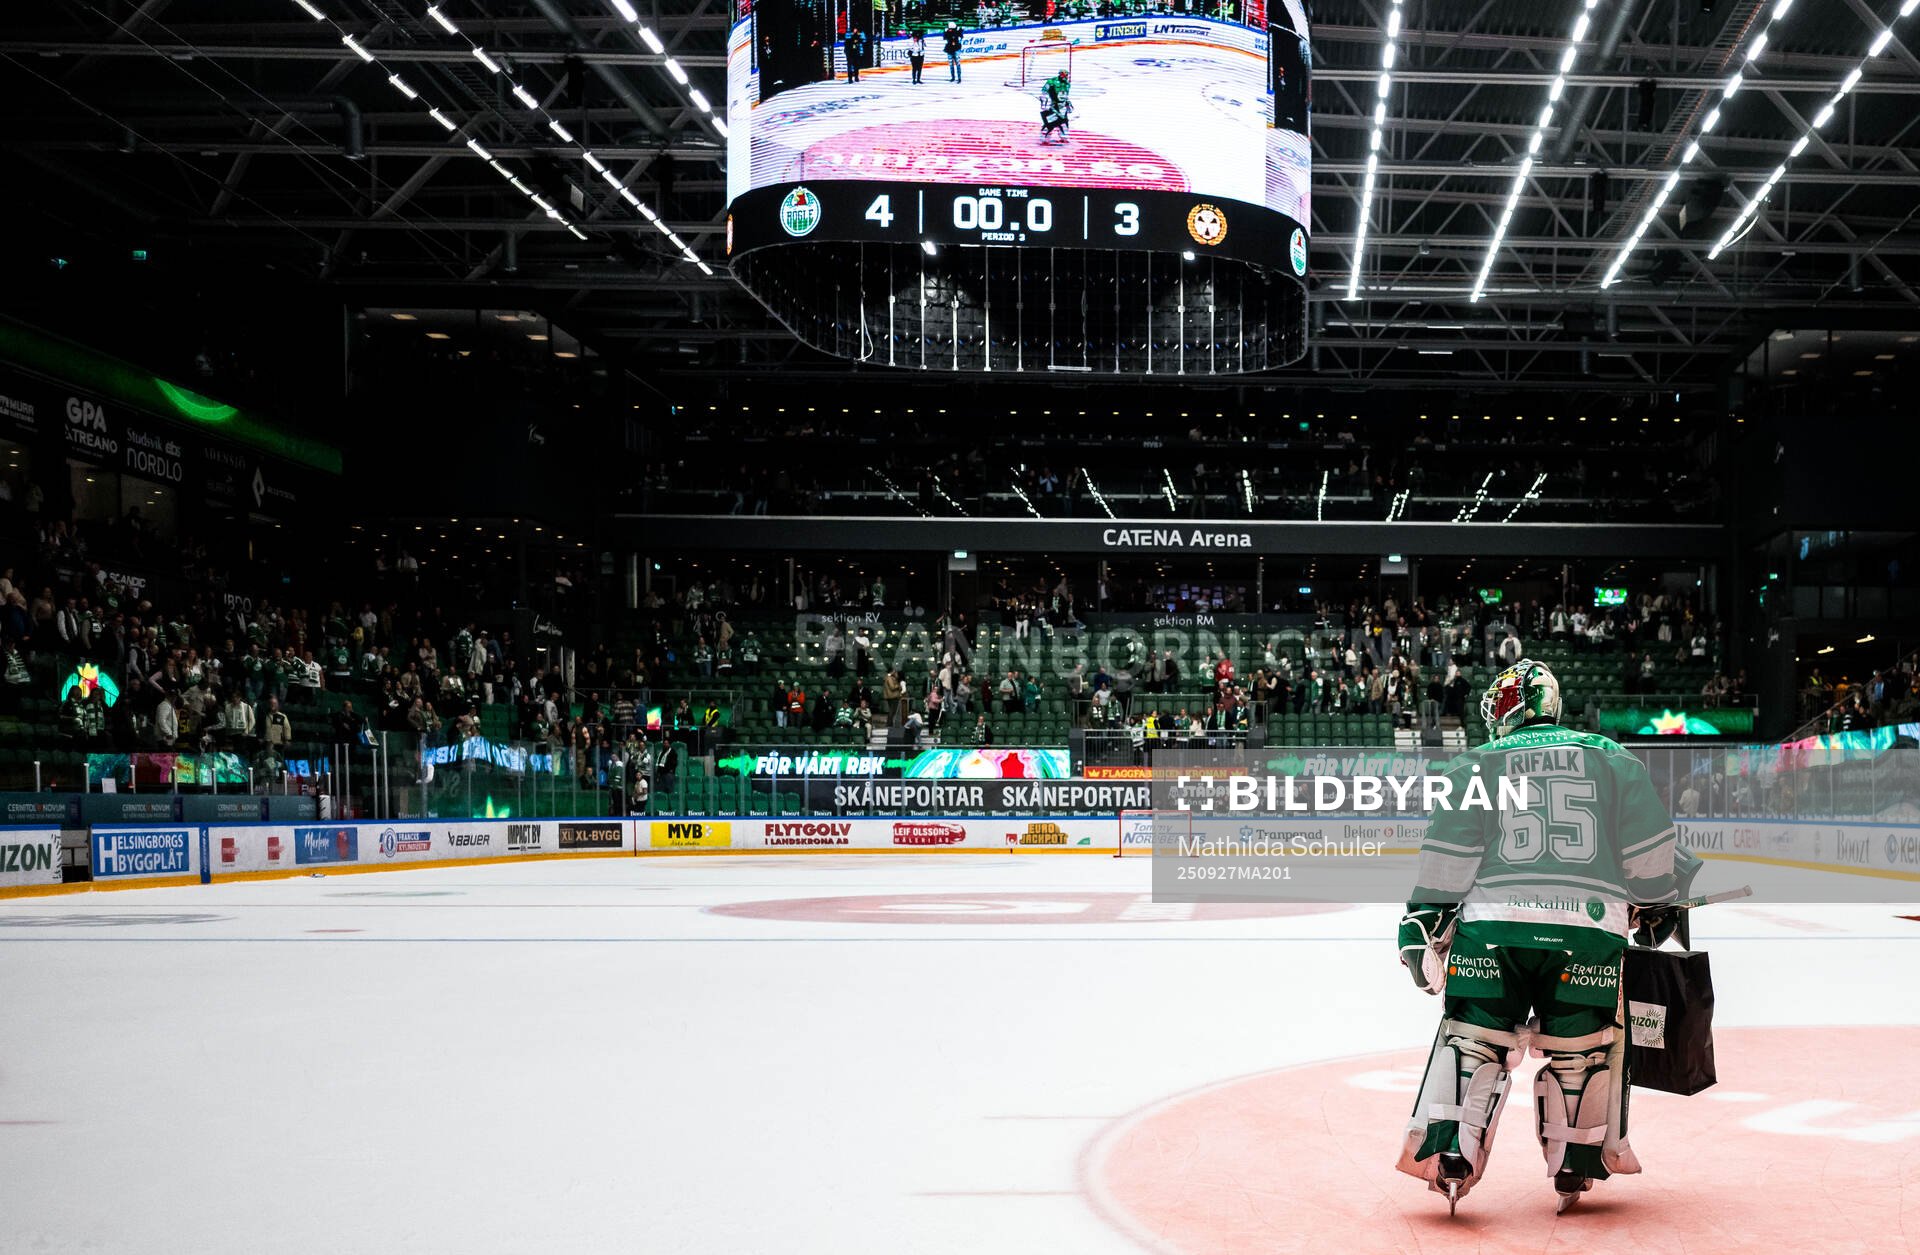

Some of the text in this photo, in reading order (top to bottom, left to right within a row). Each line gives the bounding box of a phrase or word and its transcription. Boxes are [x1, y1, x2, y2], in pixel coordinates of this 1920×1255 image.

[979, 188, 1028, 198] GAME TIME
[865, 195, 893, 227] 4
[953, 196, 1053, 231] 00.0
[1114, 204, 1139, 236] 3
[982, 232, 1026, 242] PERIOD 3
[66, 397, 108, 433] GPA
[1103, 529, 1252, 547] CATENA Arena
[822, 612, 881, 624] sektion RV
[1154, 615, 1214, 627] sektion RM
[755, 750, 886, 775] FÖR VÅRT RBK
[1303, 752, 1430, 776] FÖR VÅRT RBK
[1510, 750, 1580, 775] RIFALK
[1185, 769, 1227, 779] KRONAN
[834, 781, 984, 807] SKÅNEPORTAR
[1002, 781, 1151, 807] SKÅNEPORTAR
[765, 823, 852, 836] FLYTGOLV
[1028, 823, 1057, 834] EURO
[1497, 777, 1598, 864] 65
[508, 824, 542, 844] IMPACT BY
[562, 831, 573, 841] XL
[668, 824, 703, 838] MVB
[894, 828, 950, 836] LEIF OLSSONS
[1020, 833, 1069, 845] JACKPOT
[1344, 825, 1381, 839] Dekor
[1677, 824, 1724, 851] Boozt
[1836, 829, 1870, 864] Boozt
[119, 848, 184, 873] BYGGPLÅT
[1507, 894, 1580, 913] Backahill
[1457, 966, 1500, 979] NOVUM
[1570, 975, 1617, 988] NOVUM
[1630, 1015, 1659, 1029] RIZON
